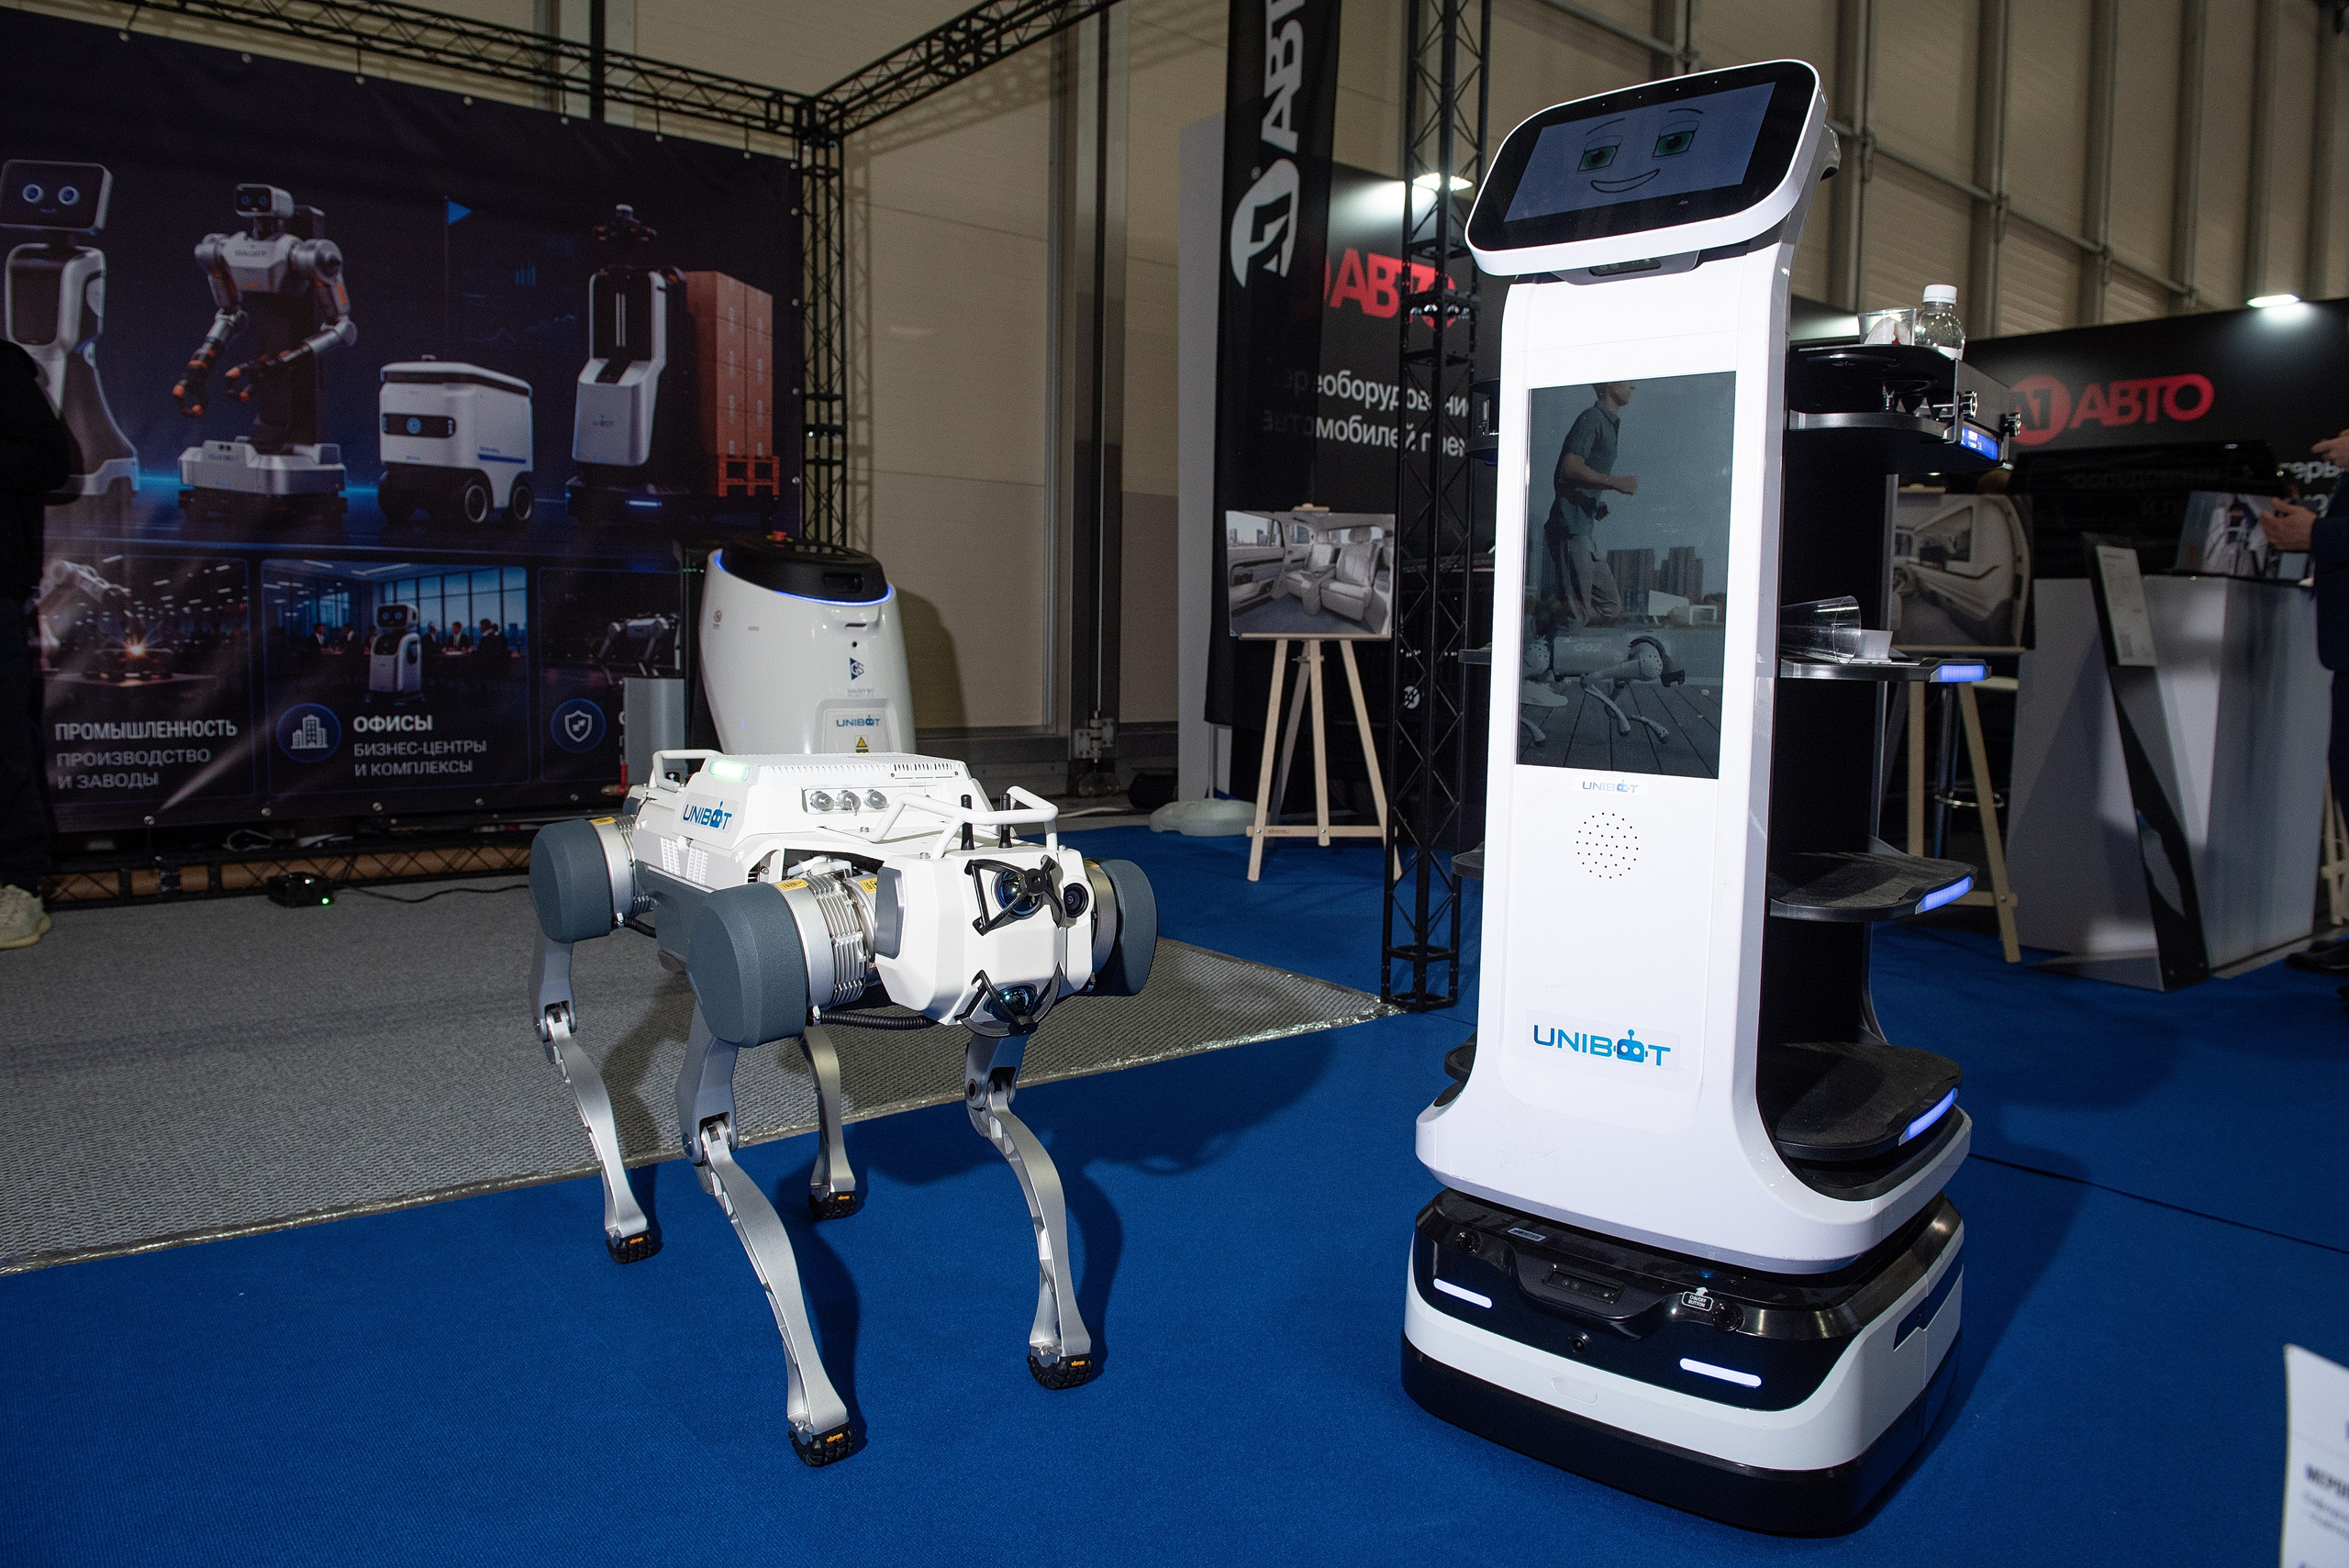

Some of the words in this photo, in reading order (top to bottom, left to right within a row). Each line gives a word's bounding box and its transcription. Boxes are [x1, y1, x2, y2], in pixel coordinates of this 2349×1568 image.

[2069, 373, 2215, 430] АВТО
[55, 719, 238, 741] ПРОМЫШЛЕННОСТЬ
[353, 714, 433, 732] ОФИСЫ
[836, 715, 881, 728] UNIBOT
[354, 740, 487, 757] БИЗНЕС-ЦЕНТРЫ
[56, 748, 211, 768] ПРОИЗВОДСТВО
[354, 763, 367, 777] И
[371, 760, 473, 777] КОМПЛЕКСЫ
[58, 774, 72, 790] И
[76, 772, 159, 789] ЗАВОДЫ
[1582, 779, 1639, 794] UNIBOT
[683, 801, 732, 830] UNIBOT
[1533, 1024, 1671, 1066] UNIBOT
[1688, 1299, 1706, 1308] BUTTON
